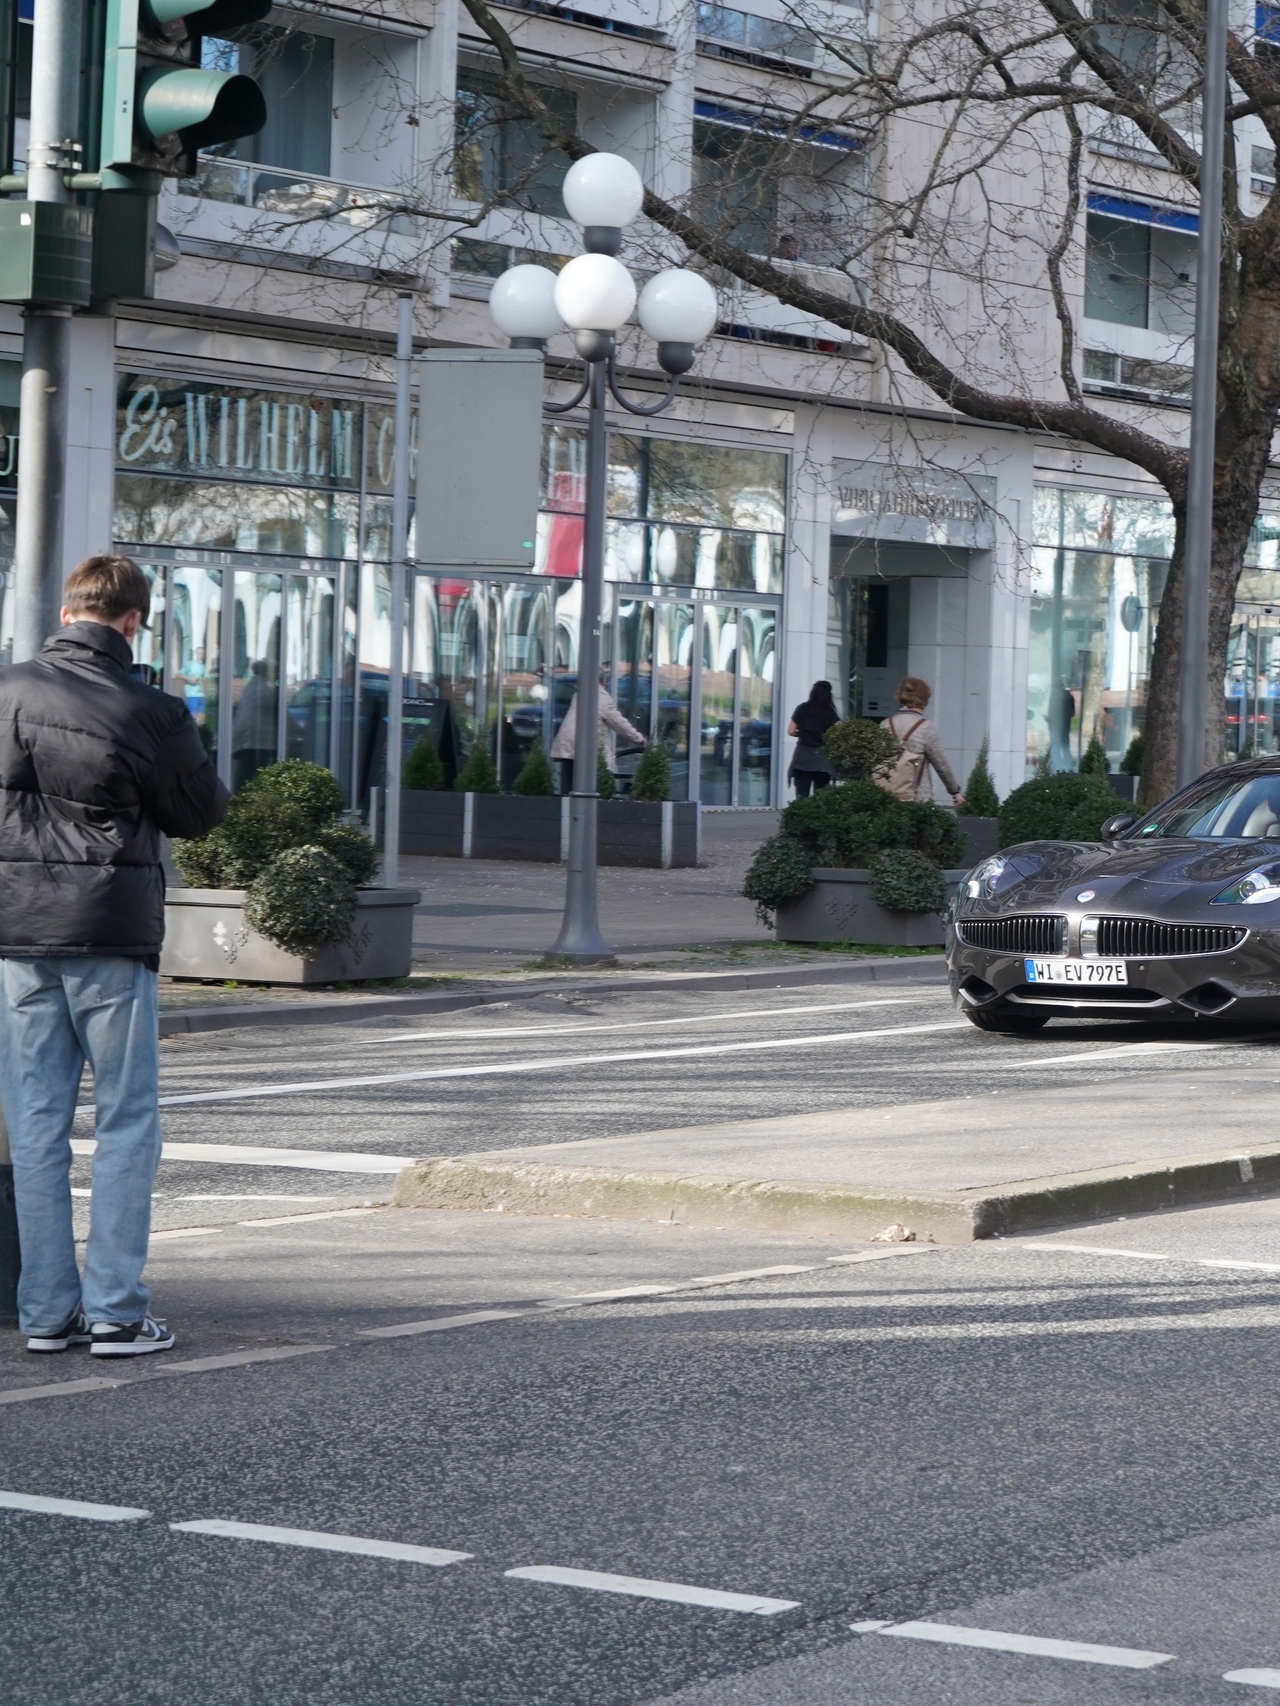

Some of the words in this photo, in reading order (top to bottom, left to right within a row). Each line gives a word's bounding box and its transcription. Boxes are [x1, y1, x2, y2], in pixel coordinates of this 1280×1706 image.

[119, 384, 178, 462] Eis
[184, 392, 353, 479] WILHELM
[837, 485, 874, 511] VIER
